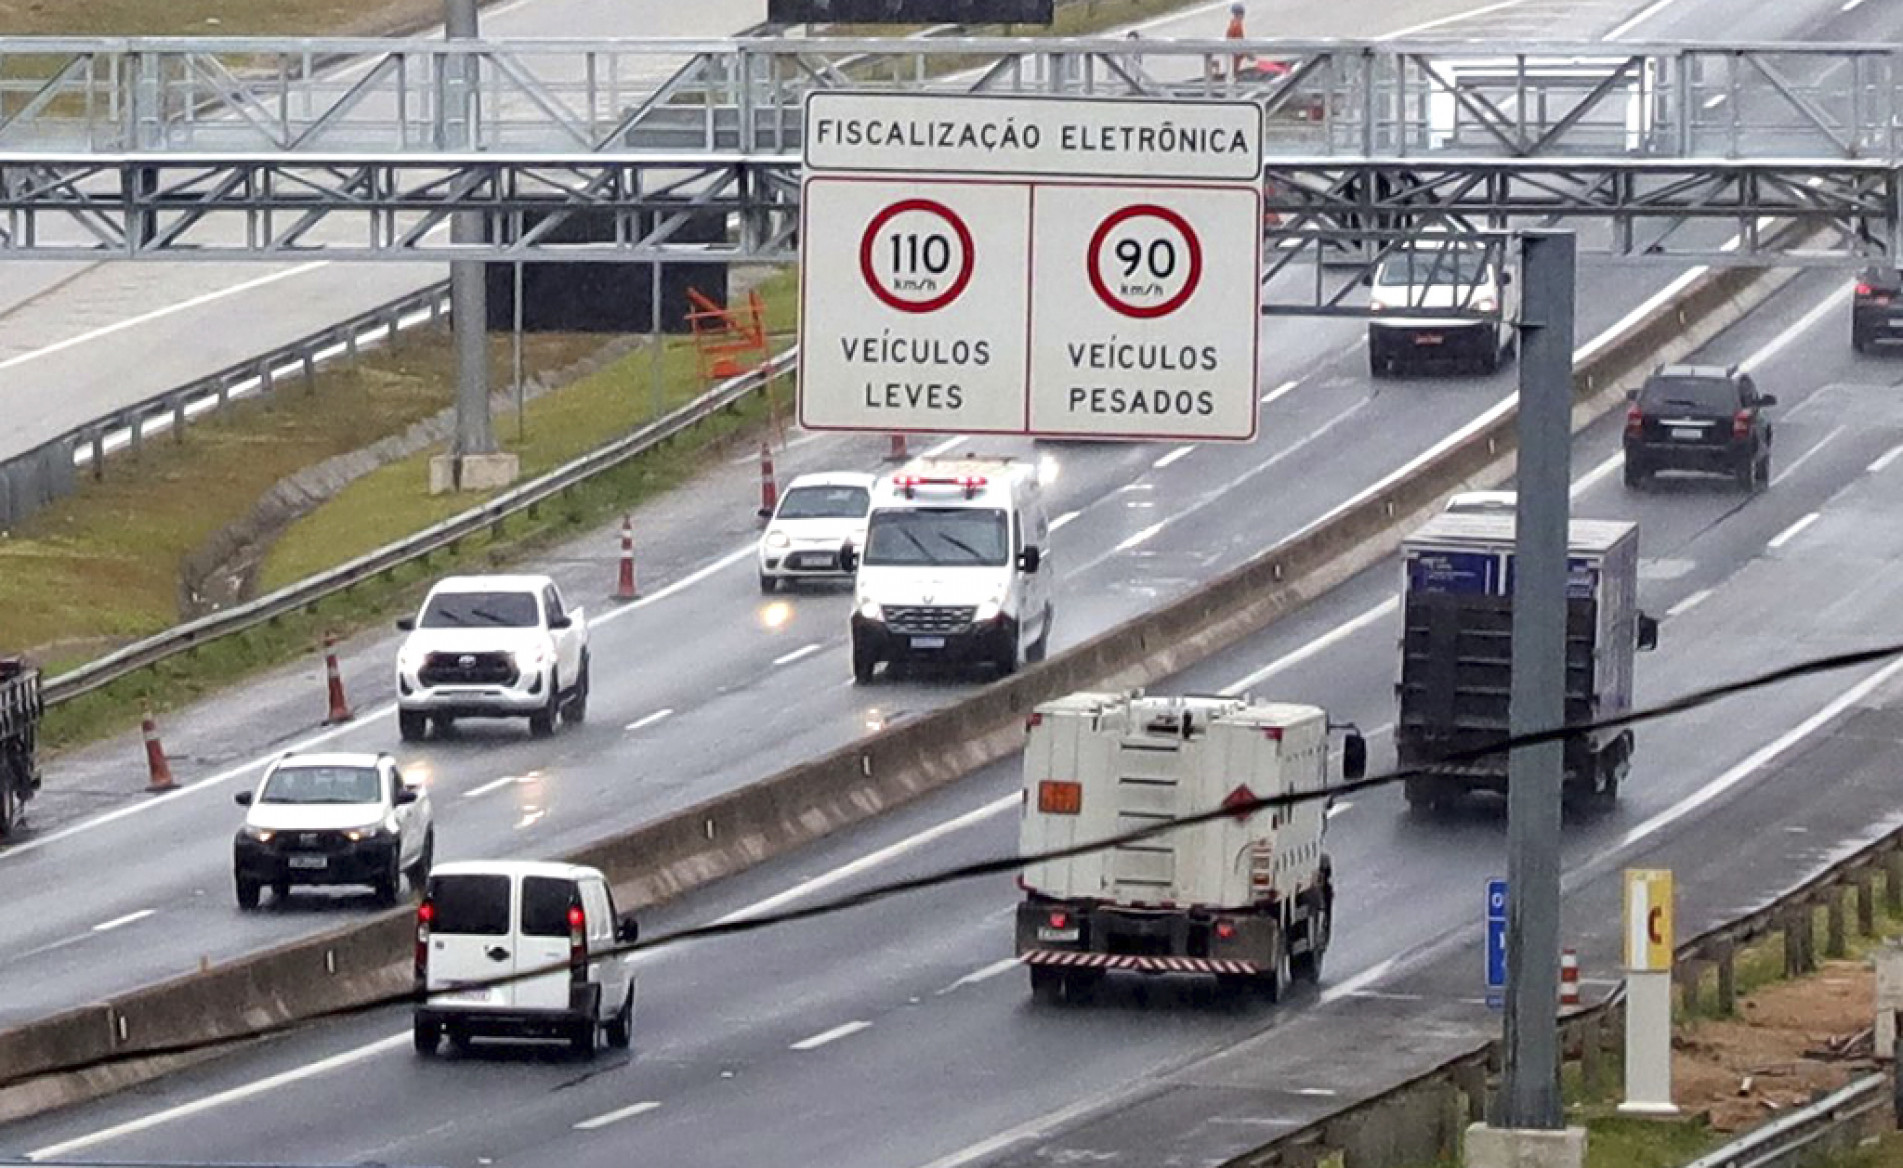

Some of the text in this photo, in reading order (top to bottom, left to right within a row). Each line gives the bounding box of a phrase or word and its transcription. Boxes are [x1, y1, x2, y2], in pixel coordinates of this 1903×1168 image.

[1061, 121, 1249, 153] ELETRÔNICA
[890, 233, 950, 274] 110
[1115, 238, 1175, 279] 90
[893, 279, 937, 291] km/h
[1120, 284, 1164, 296] km/h
[841, 329, 990, 365] VEÍCULOS
[1067, 335, 1218, 370] VEÍCULOS
[865, 383, 963, 409] LEVES
[1069, 388, 1214, 415] PESADOS
